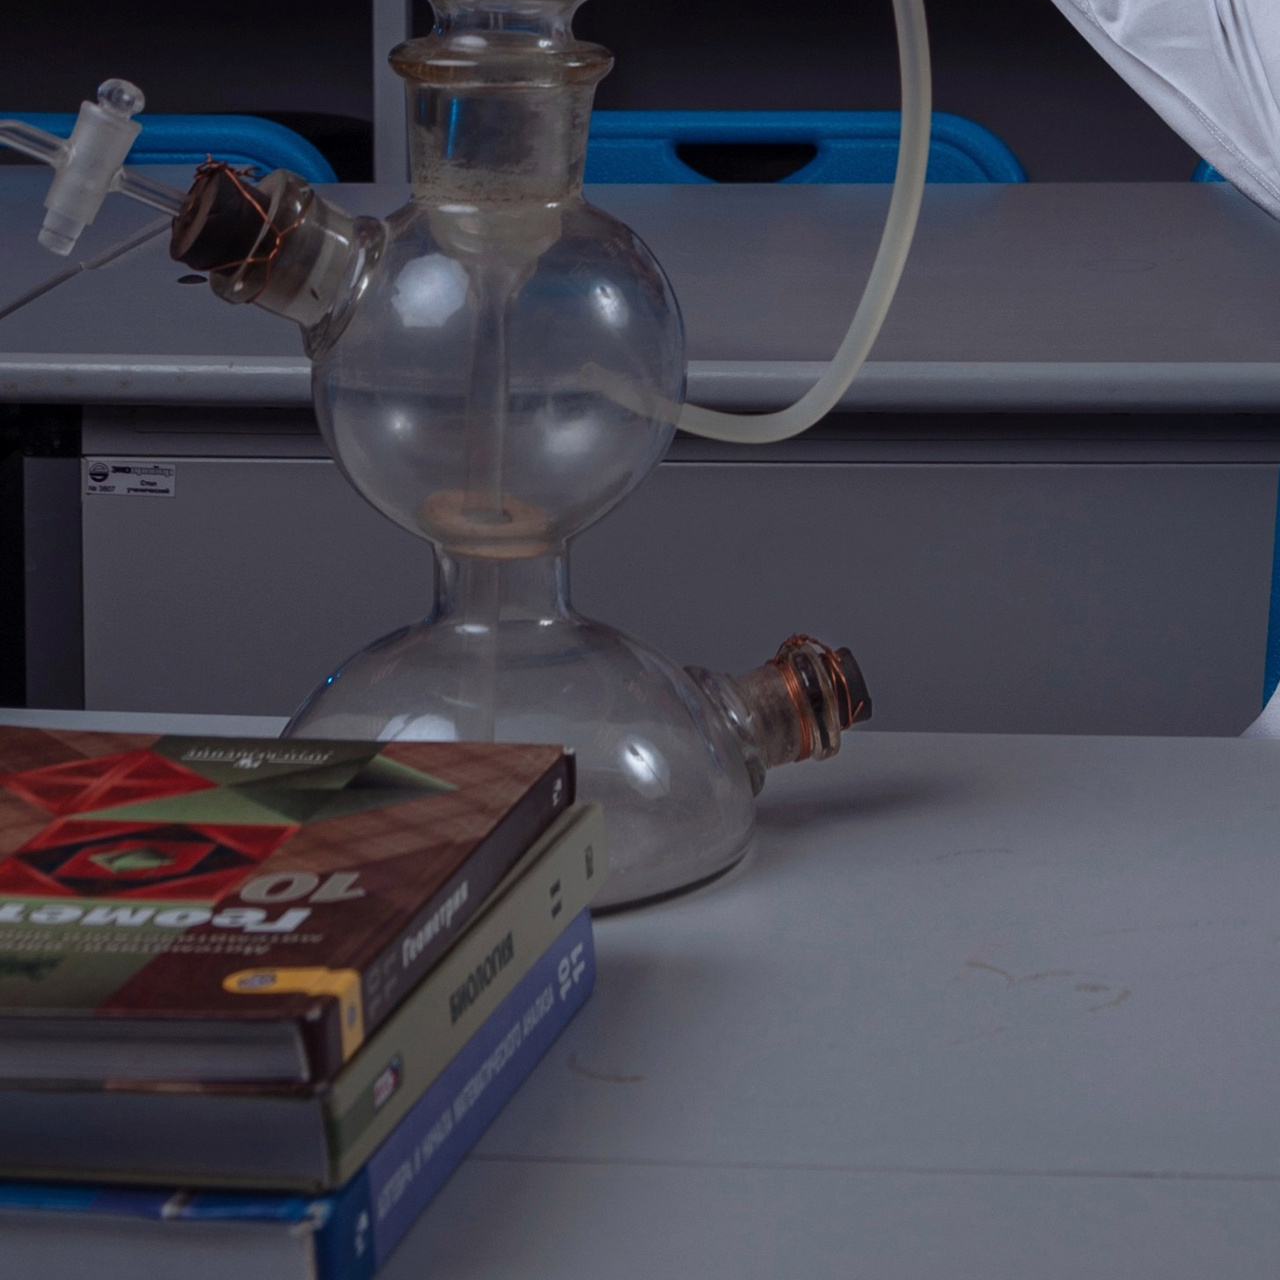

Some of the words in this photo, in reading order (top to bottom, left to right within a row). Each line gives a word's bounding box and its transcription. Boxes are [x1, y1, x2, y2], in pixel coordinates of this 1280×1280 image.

[239, 871, 366, 904] 10
[402, 879, 468, 969] Геометрия
[449, 931, 514, 1026] БИОЛОГИЯ
[557, 956, 572, 1002] 10
[570, 942, 586, 984] 11
